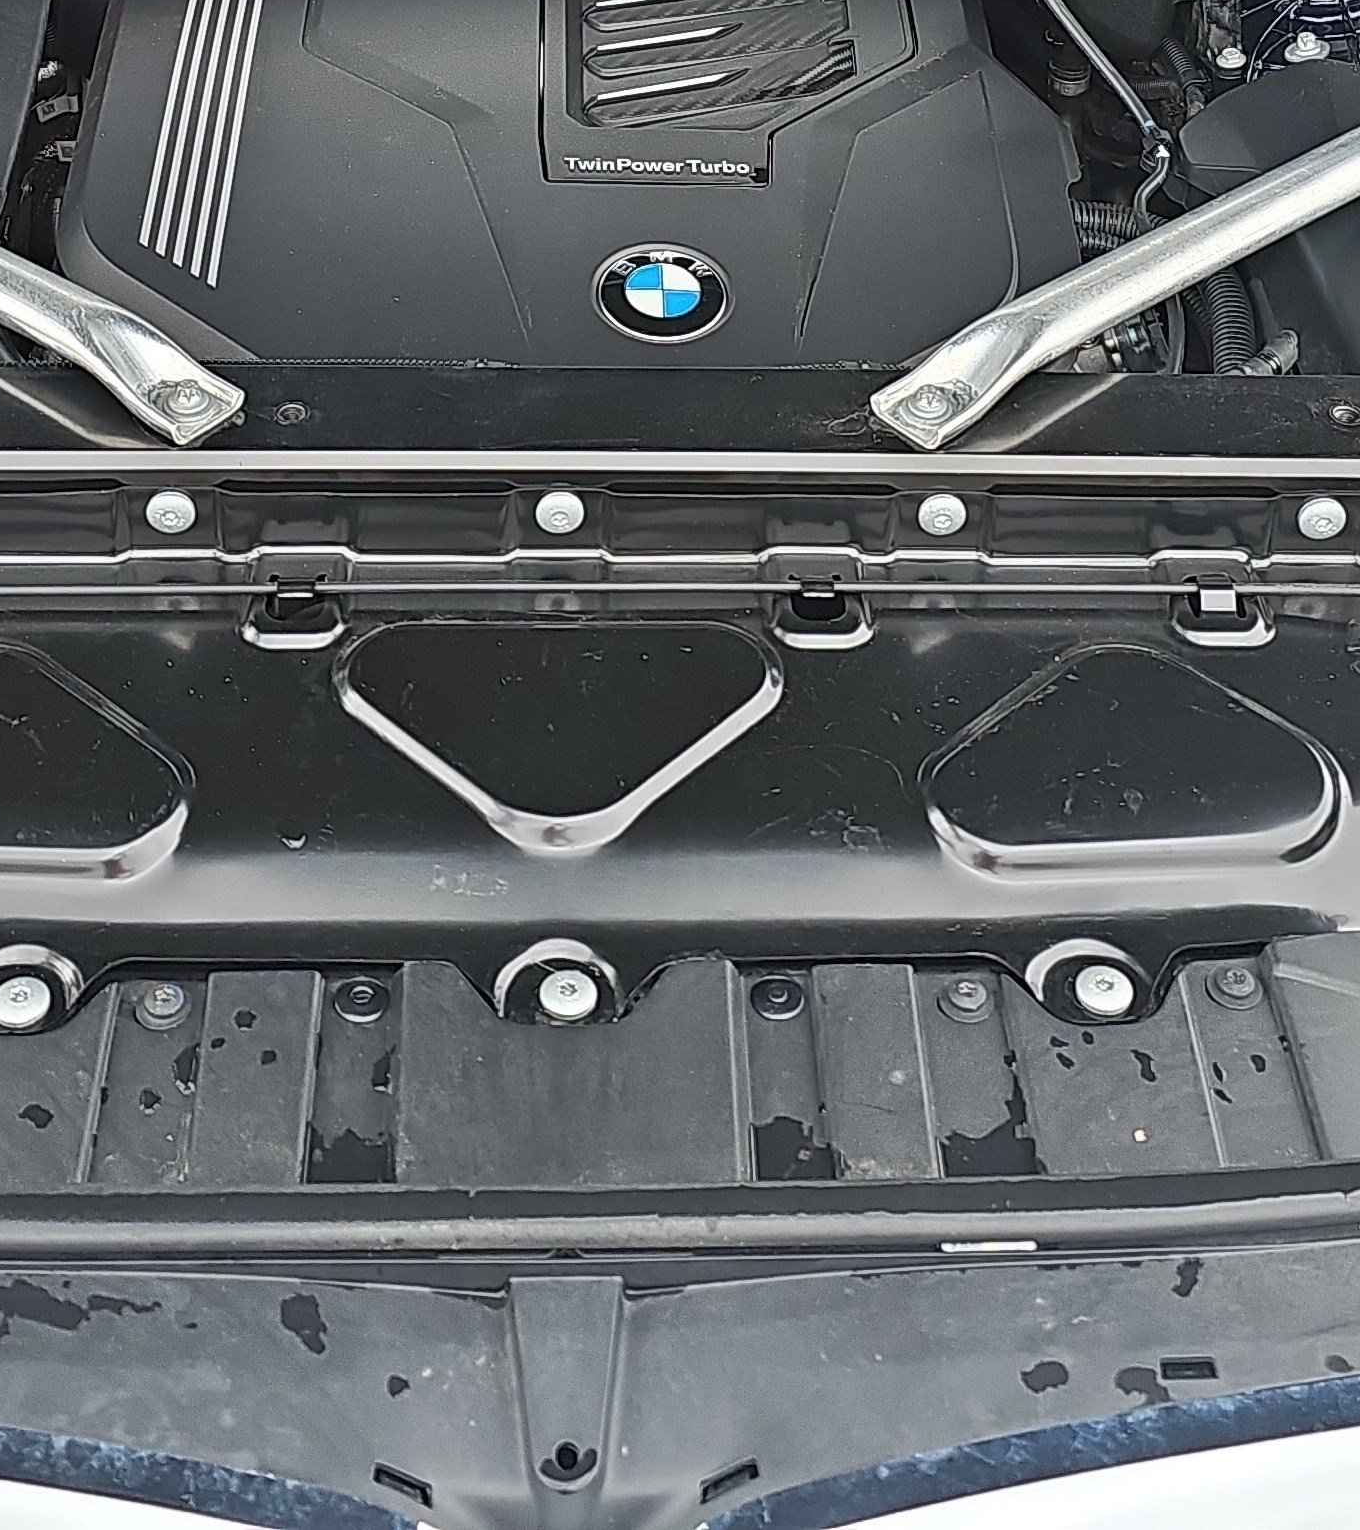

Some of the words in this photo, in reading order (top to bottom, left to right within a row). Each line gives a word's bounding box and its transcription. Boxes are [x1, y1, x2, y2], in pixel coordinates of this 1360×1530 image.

[563, 156, 685, 174] TwinPower
[685, 158, 751, 175] Turbo
[612, 250, 714, 278] BMW
